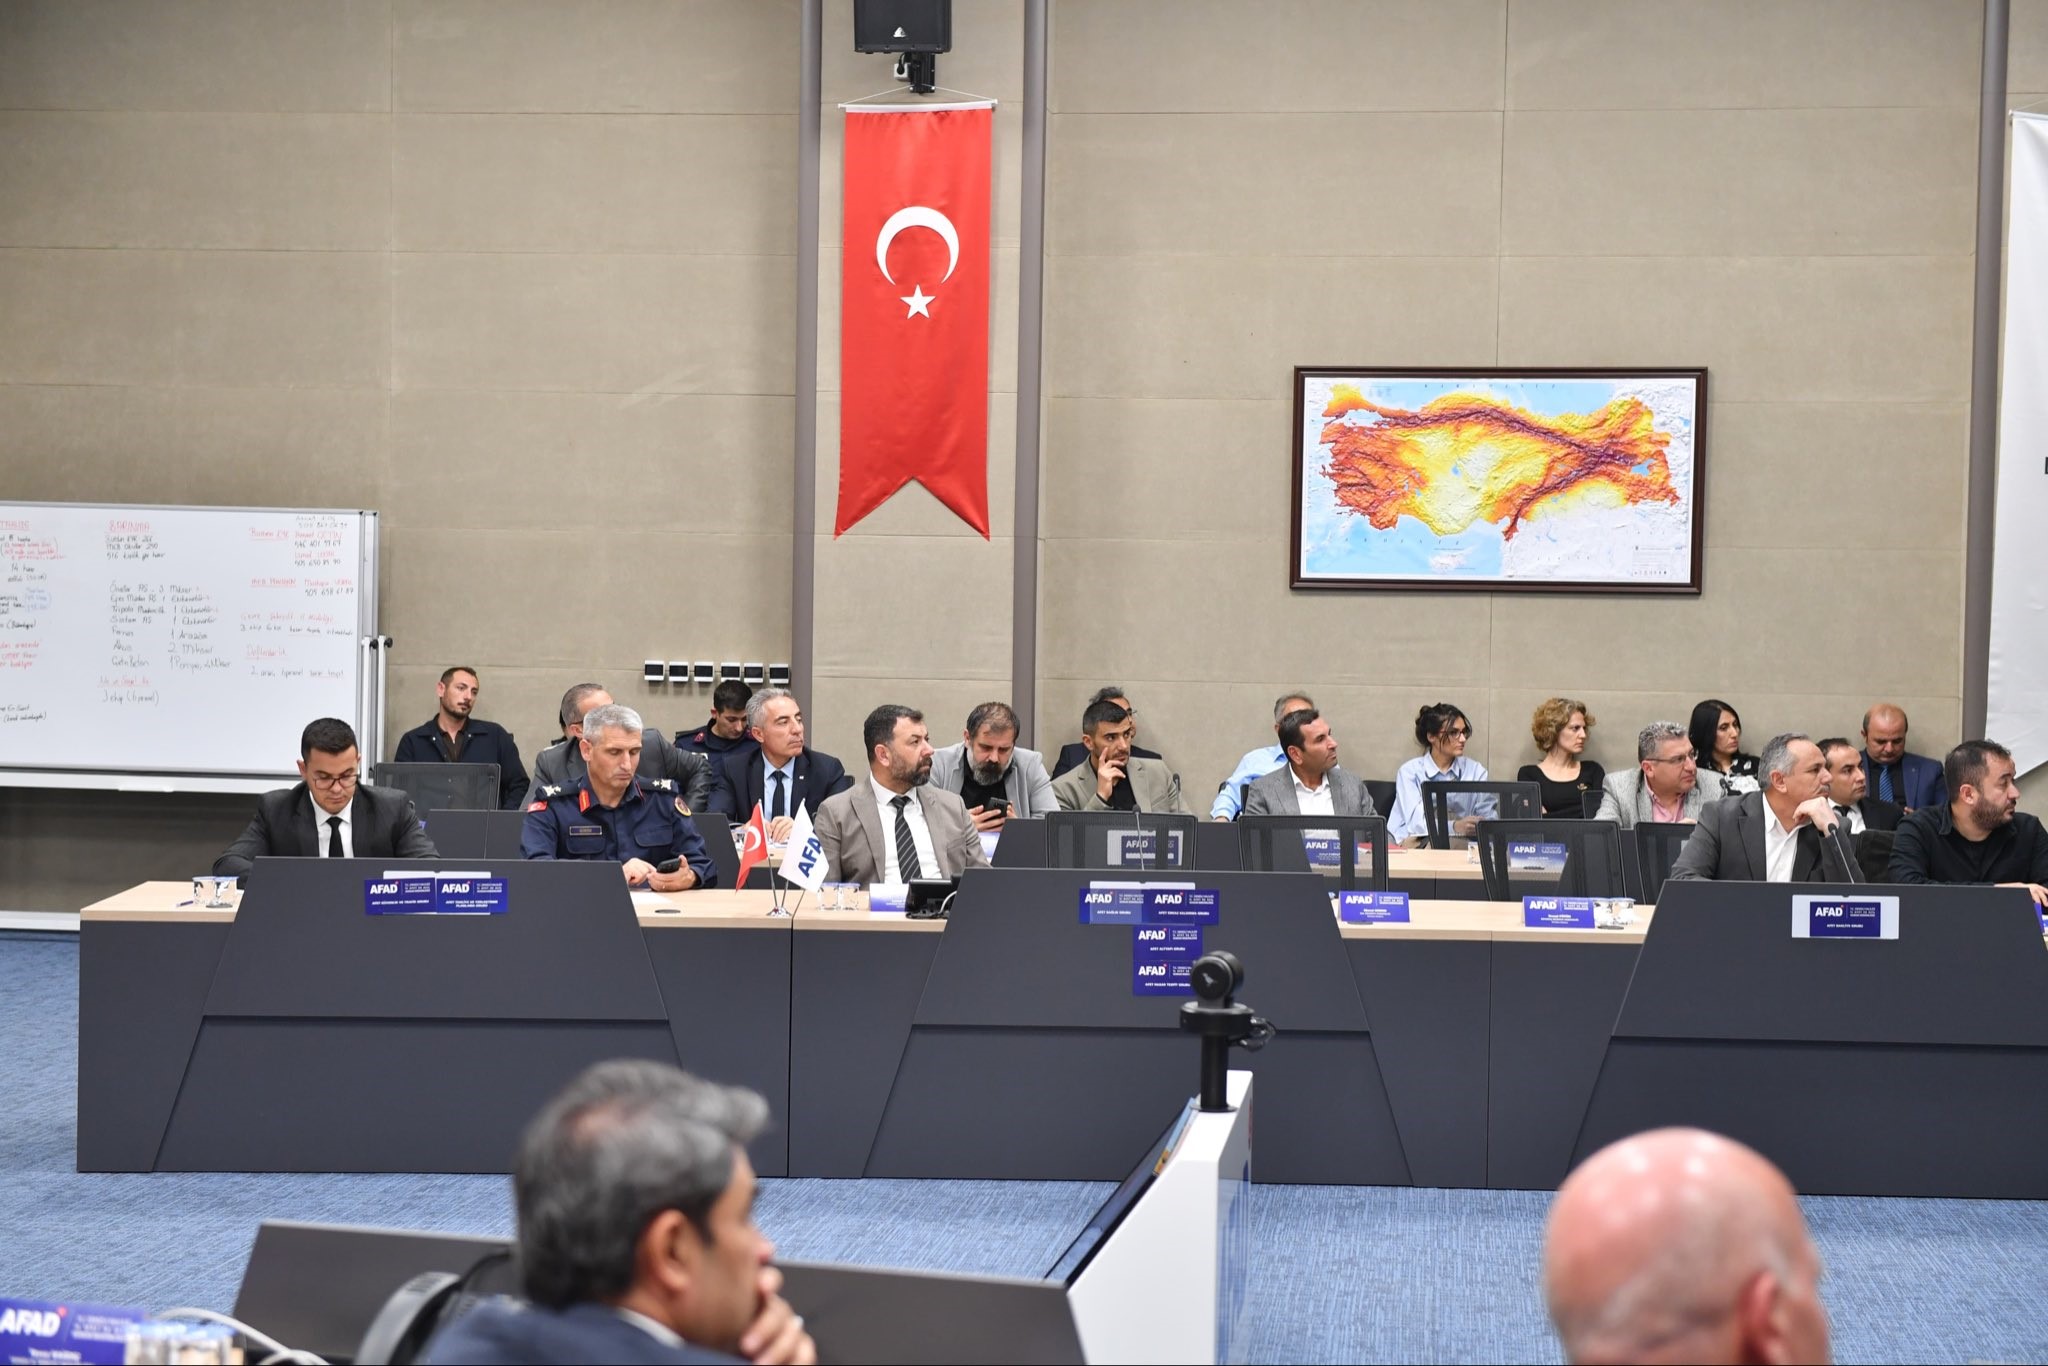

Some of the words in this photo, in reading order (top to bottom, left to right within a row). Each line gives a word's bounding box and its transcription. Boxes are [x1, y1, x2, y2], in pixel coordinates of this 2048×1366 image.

[1126, 839, 1148, 848] AFAD
[1305, 841, 1328, 849] AFAD
[1513, 845, 1536, 854] AFAD
[370, 884, 398, 895] AFAD
[442, 883, 470, 894] AFAD
[1085, 894, 1112, 904] AFAD
[1155, 894, 1182, 905] AFAD
[1346, 895, 1372, 905] AFAD
[1530, 901, 1557, 910] AFAD
[1815, 907, 1843, 917] AFAD
[1139, 930, 1165, 940] AFAD
[1139, 966, 1165, 976] AFAD
[0, 1307, 61, 1338] AFAD
